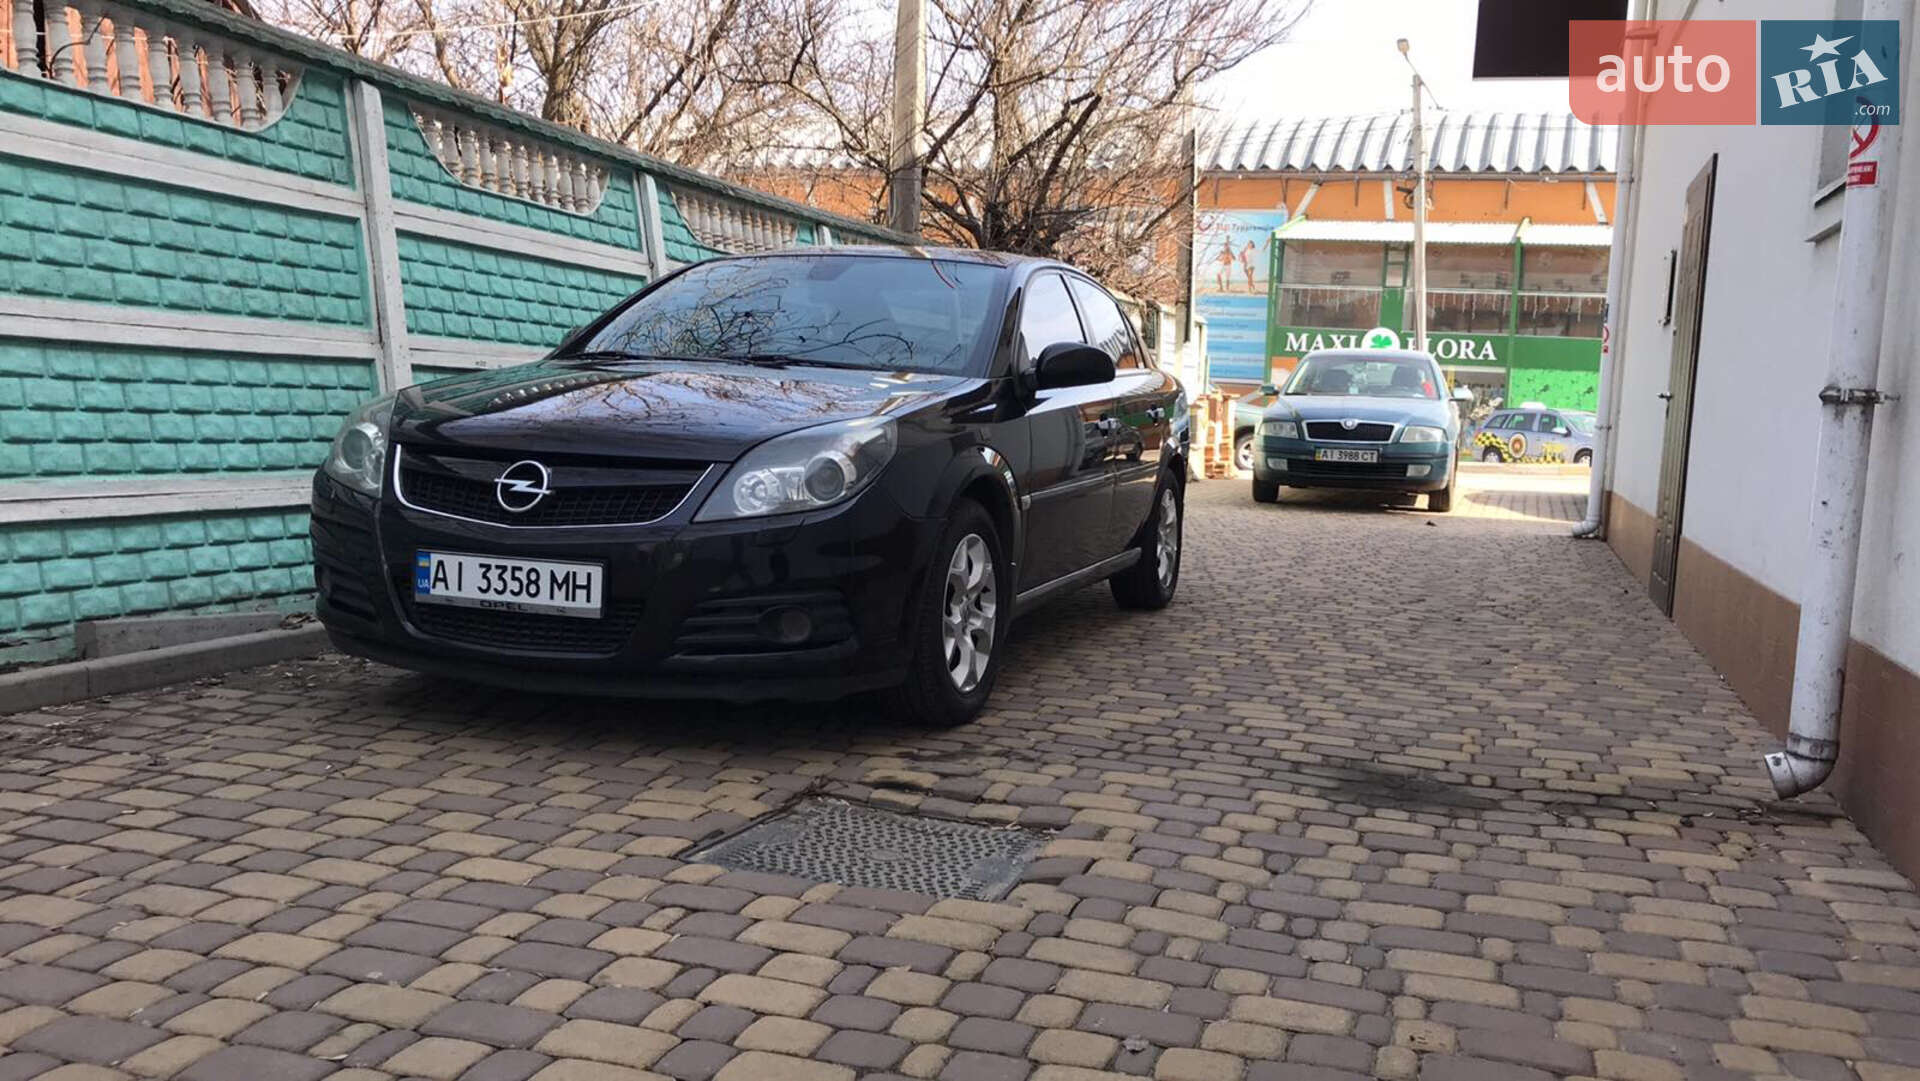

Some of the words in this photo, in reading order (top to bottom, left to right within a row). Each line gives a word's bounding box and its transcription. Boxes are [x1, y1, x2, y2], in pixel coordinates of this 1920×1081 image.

[1285, 332, 1361, 351] MAXI
[417, 578, 430, 589] UA
[431, 559, 463, 592] AI
[477, 562, 541, 598] 3358
[550, 569, 592, 604] MH
[479, 600, 528, 612] OPEL
